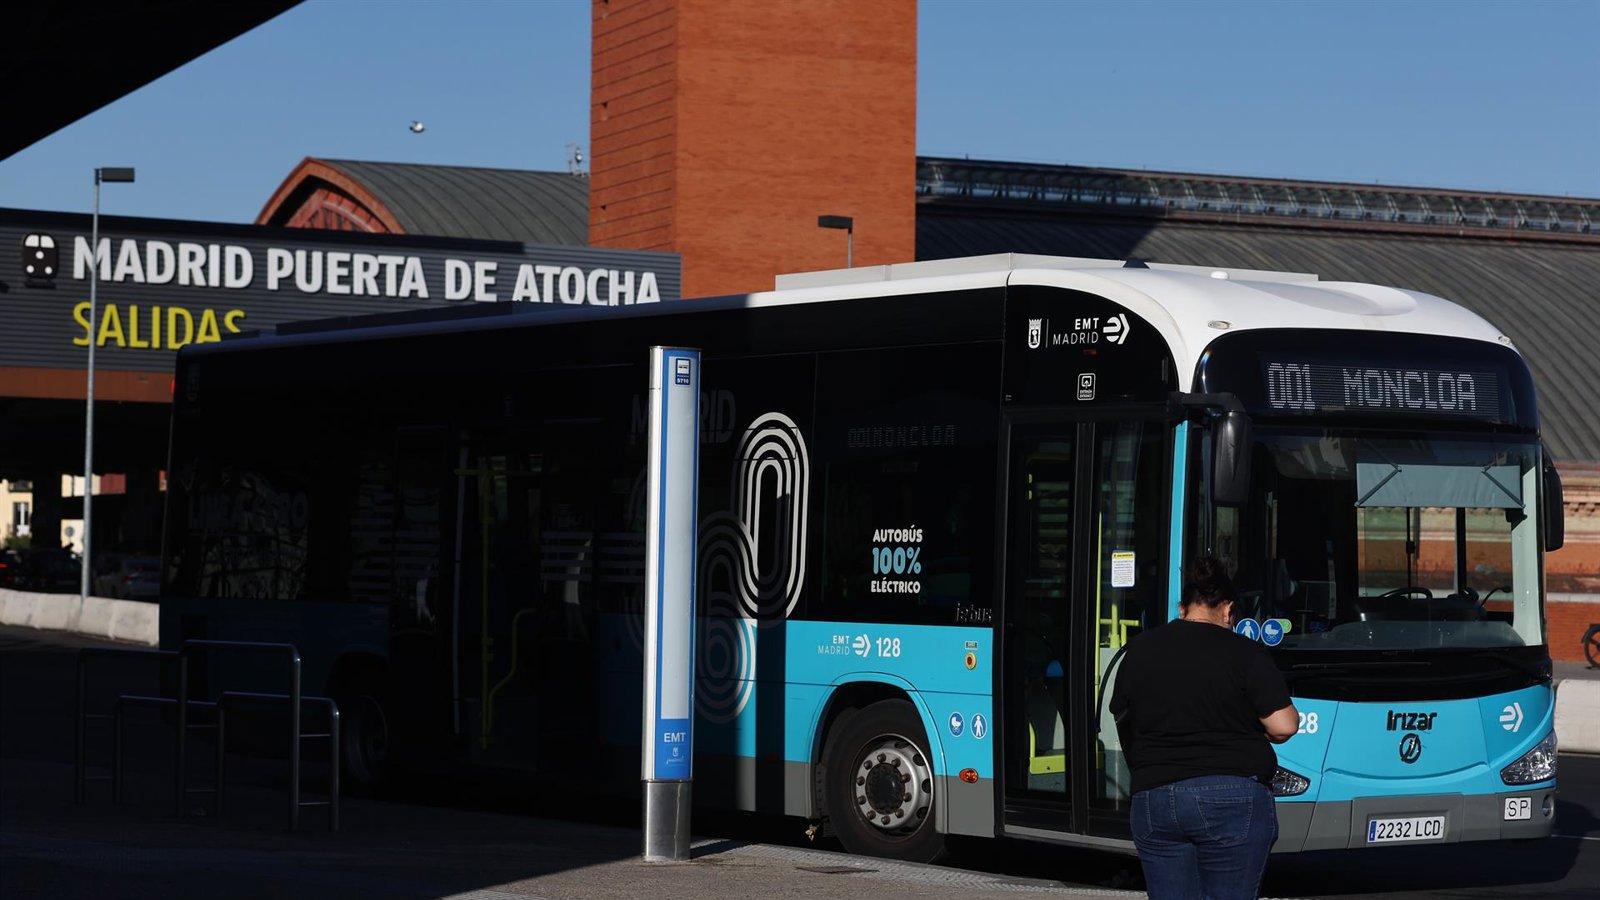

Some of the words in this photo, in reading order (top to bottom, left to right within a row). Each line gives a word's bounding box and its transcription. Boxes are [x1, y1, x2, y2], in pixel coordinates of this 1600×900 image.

[73, 236, 253, 289] MADRID
[267, 248, 429, 299] PUERTA
[445, 259, 498, 302] DE
[512, 264, 661, 306] ATOCHA
[1074, 317, 1100, 330] EMT
[1052, 331, 1099, 346] MADRID
[1268, 362, 1316, 410] 001
[1342, 368, 1476, 411] MONCLOA
[630, 389, 737, 446] MRID
[872, 524, 923, 543] AUTOBÚS
[872, 546, 922, 575] 100%
[870, 576, 921, 594] ELÉCTRICO
[832, 635, 850, 645] EMT
[876, 637, 901, 658] 128
[817, 645, 850, 656] MADRID
[1297, 711, 1319, 734] 28
[663, 732, 686, 743] EMT
[1377, 821, 1411, 839] 2232
[1415, 819, 1441, 837] LCD
